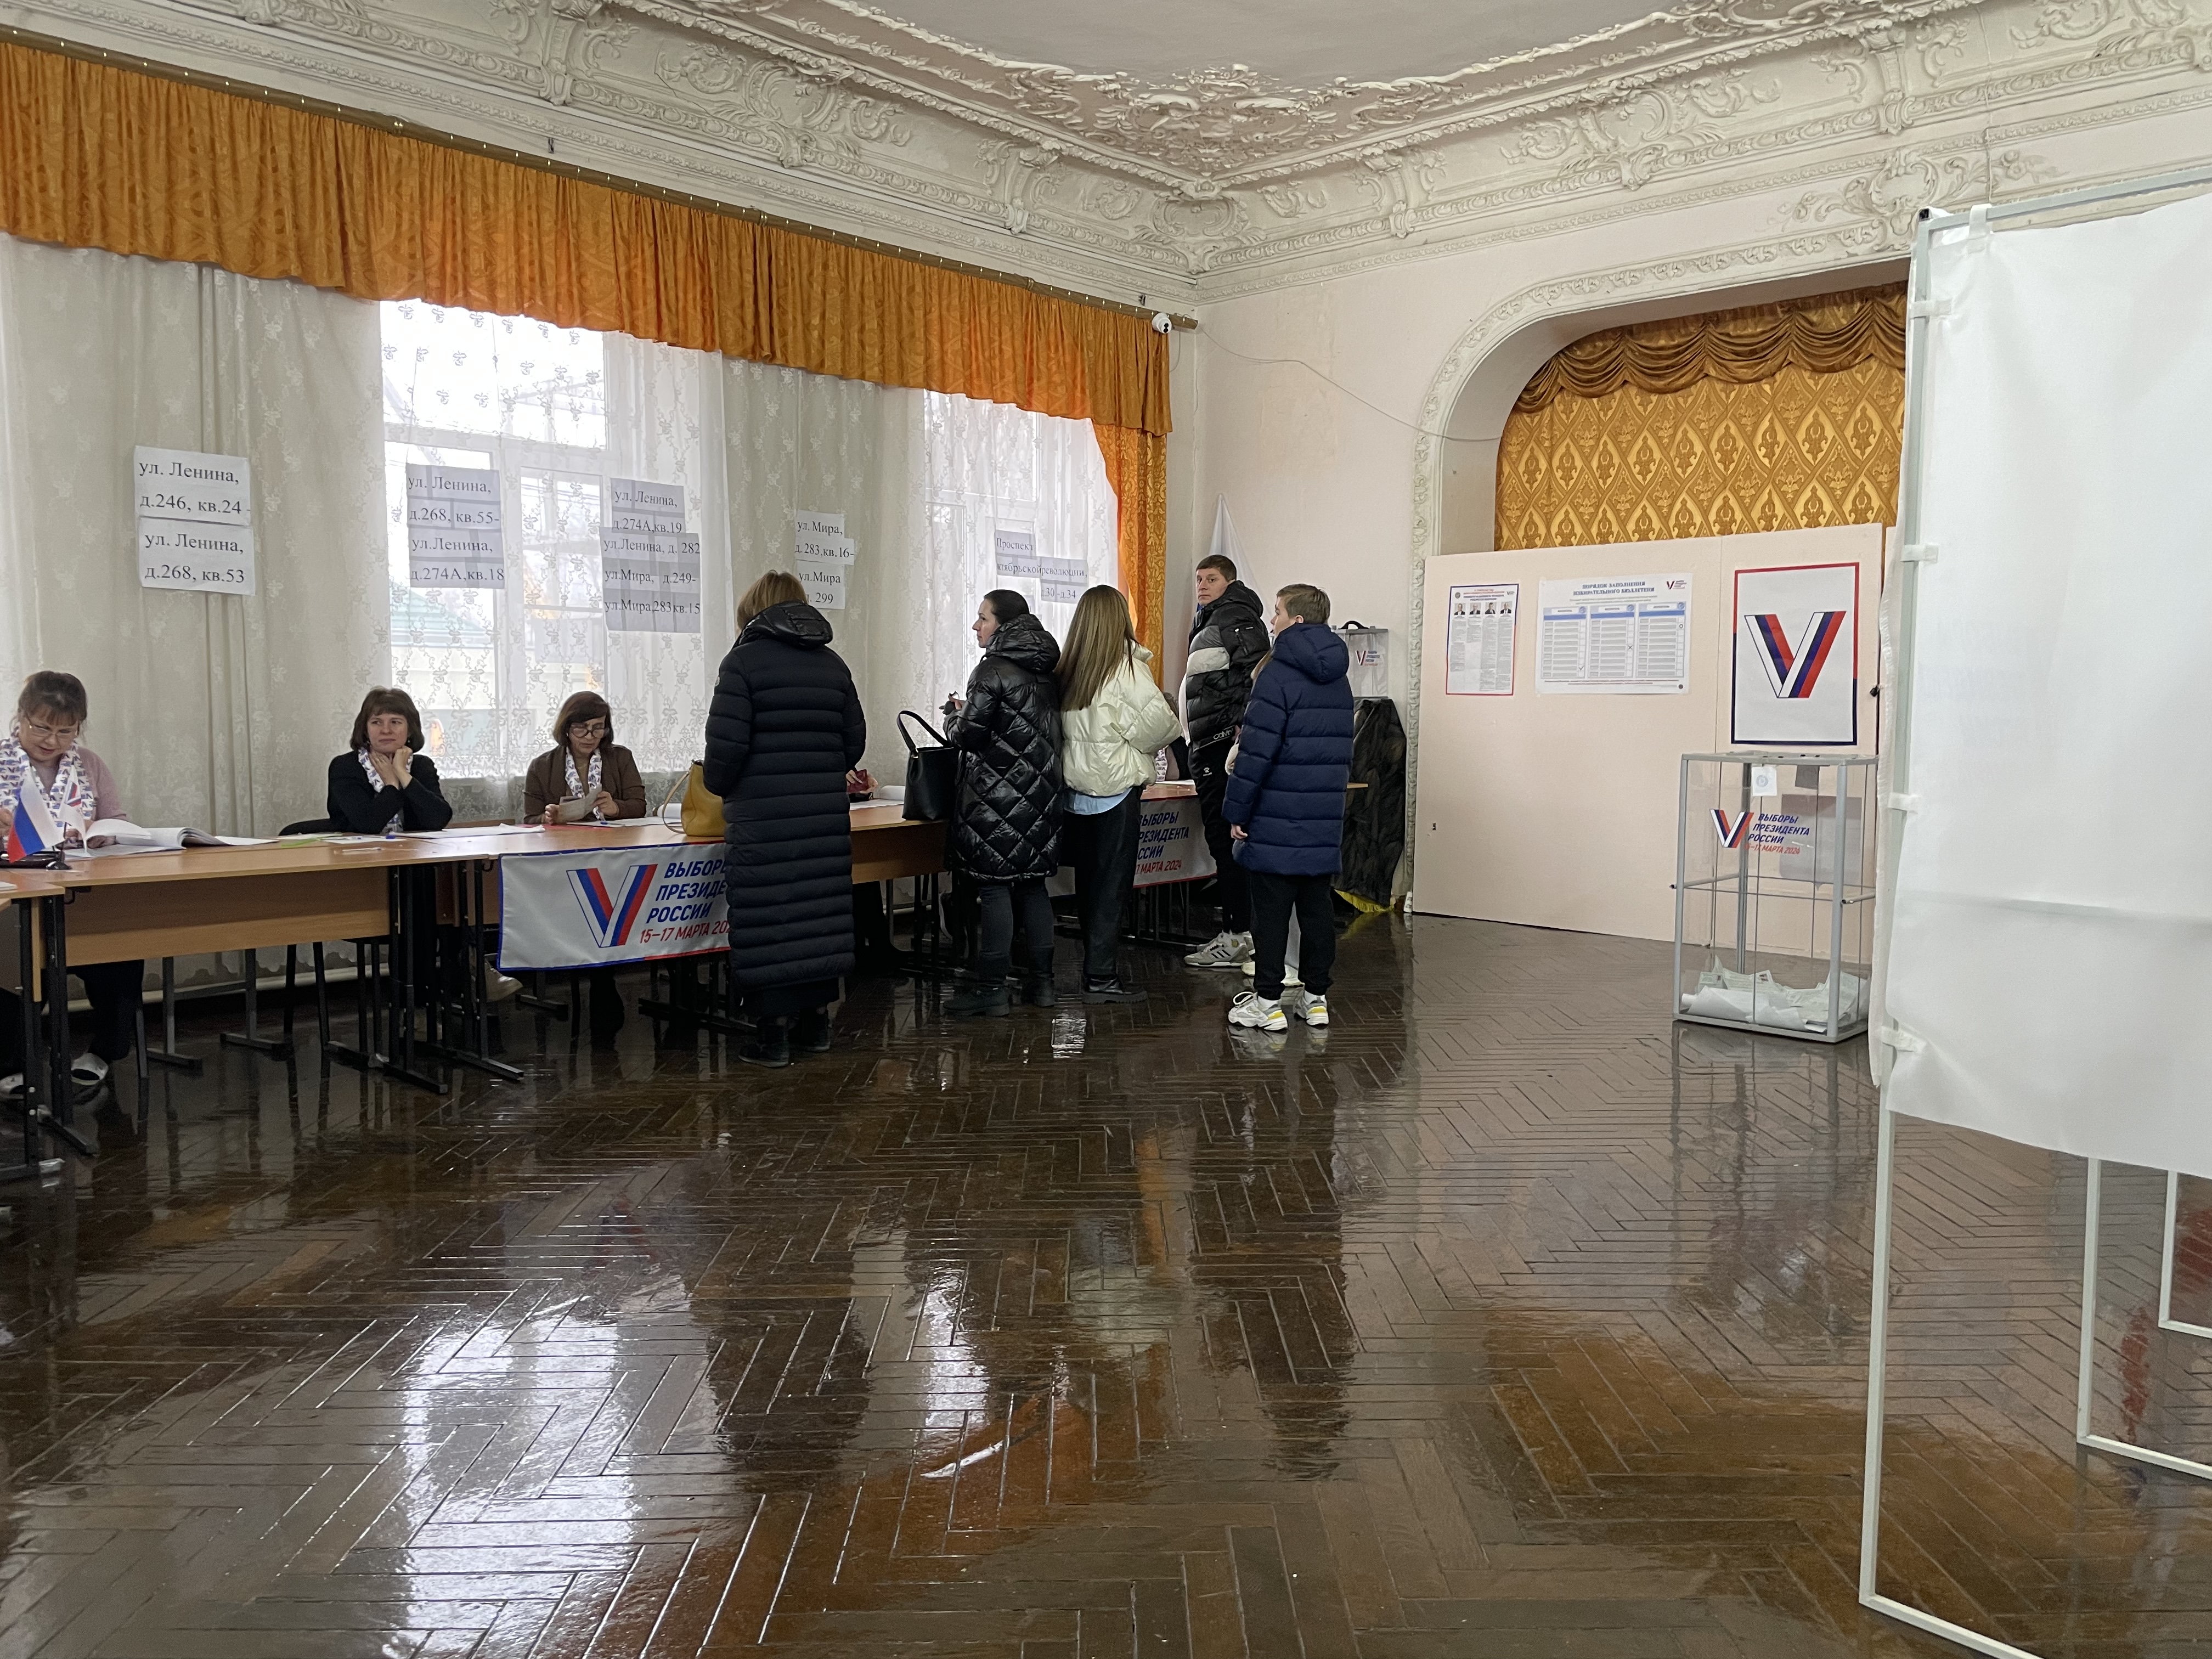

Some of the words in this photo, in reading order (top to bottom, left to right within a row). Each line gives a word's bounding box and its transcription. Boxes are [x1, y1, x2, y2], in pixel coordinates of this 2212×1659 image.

[139, 462, 163, 476] ул.
[169, 462, 239, 484] Ленина,
[408, 477, 427, 489] ул.
[432, 476, 492, 495] Ленина,
[140, 494, 191, 512] д.246,
[614, 491, 632, 503] ул.
[635, 490, 678, 508] Ленина,
[409, 507, 451, 522] д.268,
[456, 511, 500, 524] кв.55-
[797, 522, 810, 532] ул.
[812, 521, 843, 536] Мира,
[145, 534, 170, 548] ул.
[175, 533, 244, 554] Ленина,
[412, 538, 493, 553] ул.Ленина,
[681, 543, 700, 554] 282
[996, 538, 1034, 551] Проспект
[144, 565, 196, 582] д.268,
[202, 569, 245, 583] кв.53
[605, 569, 654, 584] ул.Мира,
[815, 592, 833, 604] 299
[1758, 814, 1798, 823] ВЫБОРЫ
[1139, 826, 1189, 843] РЕЗИДЕНТА
[1752, 823, 1810, 836] ПРЕЗИДЕНТА
[1748, 833, 1785, 844] РОССИИ
[1137, 845, 1164, 860] ССИИ
[1762, 845, 1783, 853] МАРТА
[664, 859, 726, 879] ВЫБОР
[1141, 861, 1164, 873] МАРТА
[656, 879, 727, 901] ПРЕЗИДЕ
[646, 902, 713, 924] РОССИИ
[675, 922, 710, 941] МАРТА
[711, 920, 730, 935] 20
